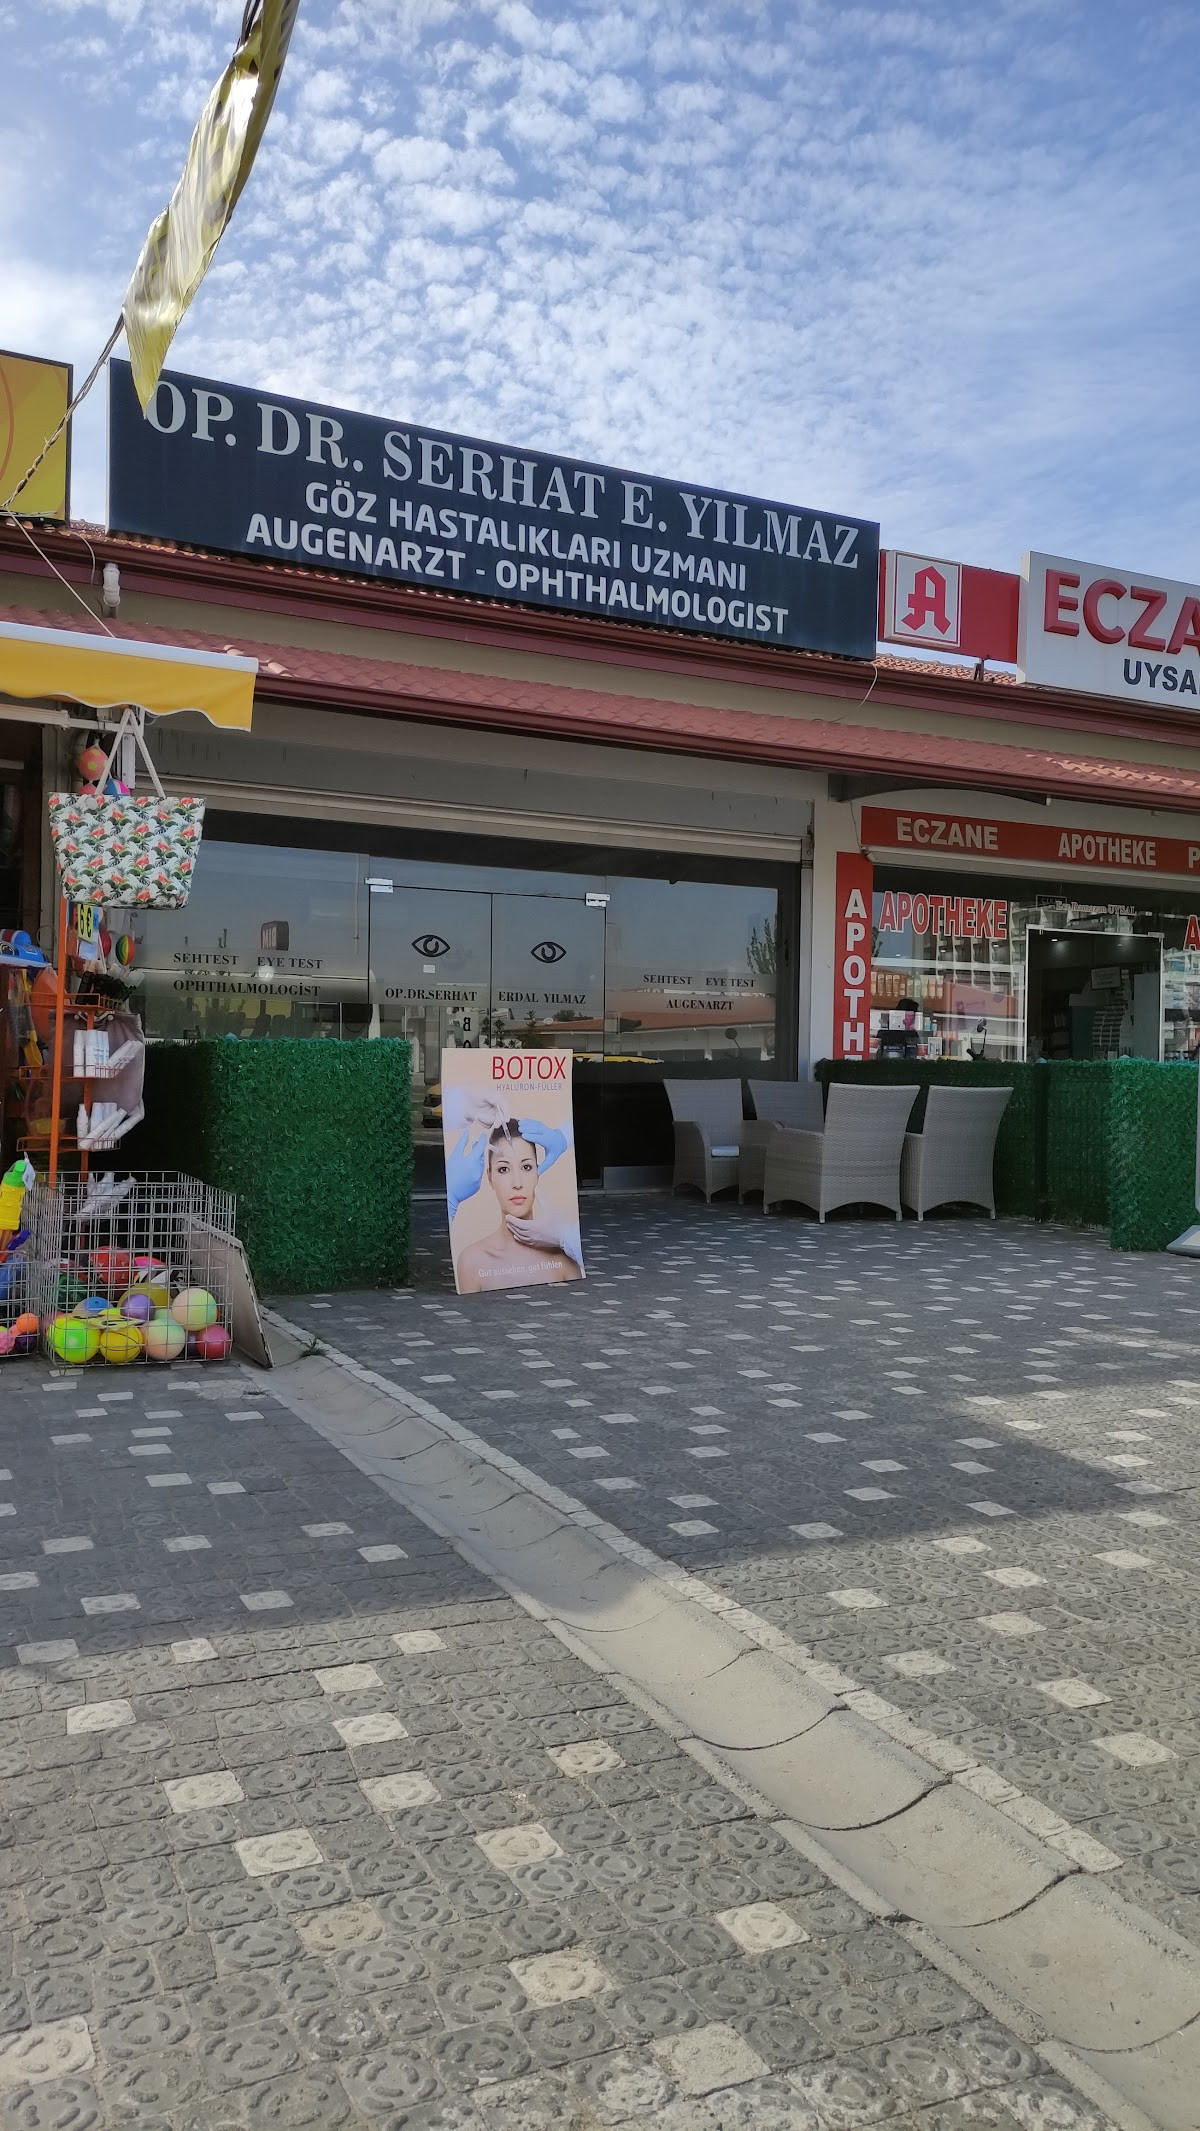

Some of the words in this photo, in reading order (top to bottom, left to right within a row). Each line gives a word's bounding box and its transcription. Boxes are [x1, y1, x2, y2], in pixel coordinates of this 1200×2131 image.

[150, 380, 237, 448] OP.
[256, 402, 364, 472] DR.
[383, 430, 605, 519] SERHAT
[621, 480, 667, 533] E.
[679, 492, 860, 569] YILMAZ
[305, 480, 377, 524] GÖZ
[389, 498, 621, 569] HASTALIKLARI
[631, 543, 747, 592] UZMANI
[246, 513, 467, 580] AUGENARZT
[495, 560, 789, 635] OPHTHALMOLOGIST
[1044, 569, 1200, 655] ECZA
[1123, 658, 1200, 696] UYSA
[896, 817, 999, 851] ECZANE
[1058, 832, 1157, 867] APOTHEKE
[879, 890, 1008, 941] APOTHEKE
[173, 952, 240, 965] SEHTEST
[257, 956, 285, 967] EYE
[289, 957, 323, 969] TEST
[643, 974, 693, 985] SEHTEST
[705, 977, 727, 987] EYE
[730, 978, 756, 988] TEST
[843, 889, 867, 1060] APOTH
[498, 991, 539, 1003] ERDAL
[544, 993, 586, 1005] YILMAZ
[666, 999, 734, 1011] AUGENARZT
[492, 1055, 567, 1080] BOTOX
[478, 1267, 493, 1278] Gut
